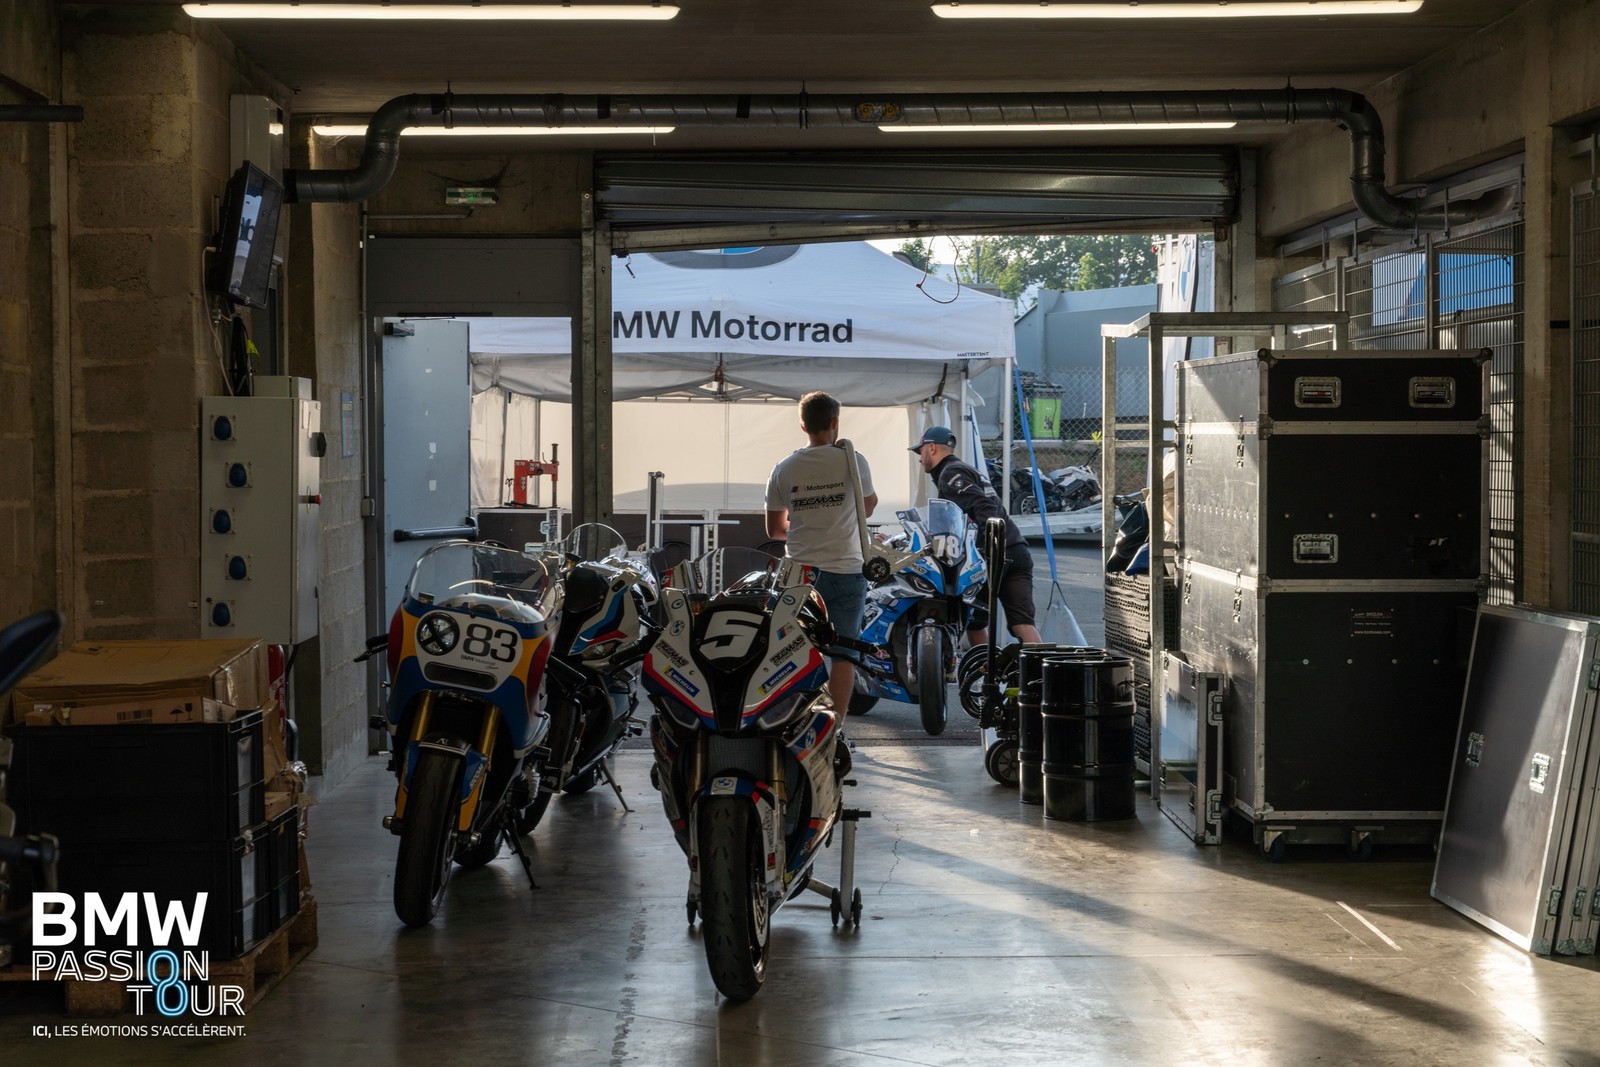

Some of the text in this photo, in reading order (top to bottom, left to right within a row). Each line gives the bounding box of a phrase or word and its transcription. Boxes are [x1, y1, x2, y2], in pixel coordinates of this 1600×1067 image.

[613, 310, 853, 343] MW Motorrad
[806, 482, 844, 492] Motorsport
[791, 493, 846, 508] TECMAS
[933, 535, 960, 559] 78
[462, 623, 518, 663] 83
[698, 610, 764, 660] 5
[769, 665, 793, 685] MICHELIN
